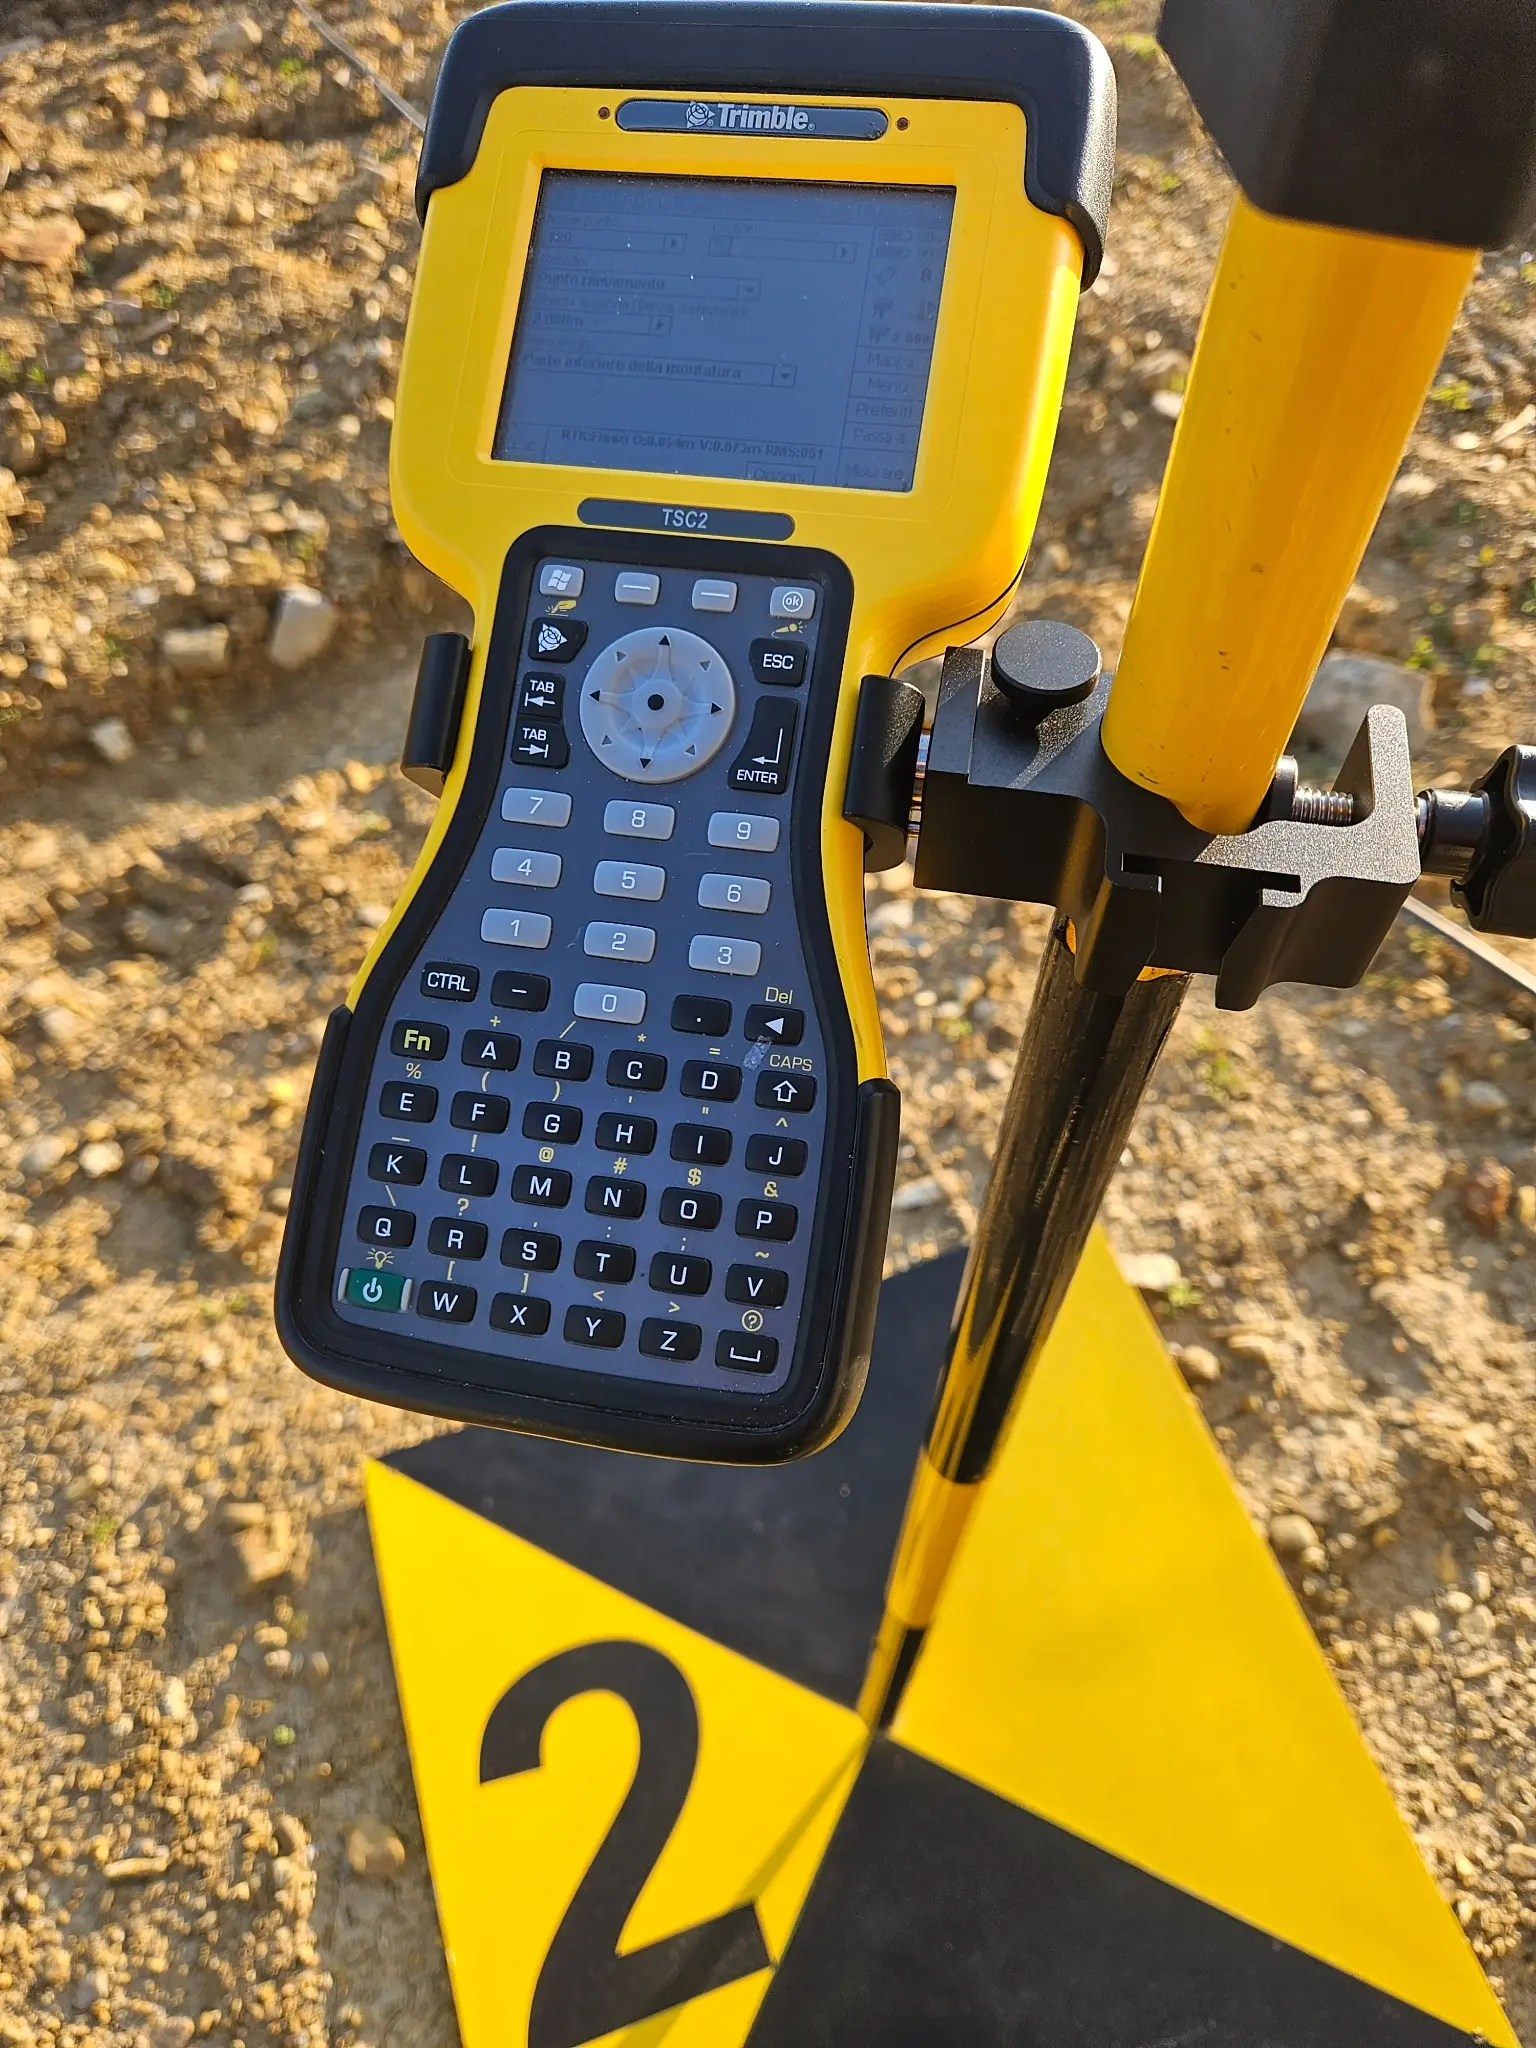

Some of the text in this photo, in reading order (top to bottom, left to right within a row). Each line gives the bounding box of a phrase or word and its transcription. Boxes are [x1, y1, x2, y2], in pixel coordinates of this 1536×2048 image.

[717, 103, 809, 131] Trimble
[662, 508, 709, 529] TSC2
[762, 652, 795, 671] ESC
[529, 679, 556, 694] TAB
[522, 727, 547, 742] TAB
[736, 769, 779, 786] ENTER
[530, 797, 544, 815] 7
[631, 810, 646, 828] 8
[737, 822, 751, 840] 9
[517, 858, 532, 877] 4
[622, 871, 636, 889] 5
[727, 884, 742, 903] 6
[510, 919, 521, 937] 1
[612, 932, 627, 951] 2
[717, 946, 732, 965] 3
[427, 972, 471, 992] CTRL
[602, 994, 617, 1013] 0
[765, 987, 794, 1005] Del
[403, 1029, 431, 1052] Fn
[481, 1041, 497, 1060] A
[555, 1051, 571, 1070] B
[769, 1053, 813, 1072] CAPS
[627, 1061, 643, 1080] C
[702, 1071, 718, 1090] D
[399, 1093, 414, 1112] E
[471, 1103, 485, 1121] F
[544, 1115, 560, 1134] G
[616, 1125, 634, 1144] H
[386, 1155, 403, 1174] K
[768, 1146, 783, 1165] J
[459, 1166, 472, 1185] L
[529, 1176, 552, 1196] M
[604, 1188, 623, 1208] N
[375, 1217, 392, 1237] Q
[756, 1210, 773, 1230] P
[446, 1229, 463, 1248] R
[521, 1242, 537, 1261] S
[596, 1253, 611, 1272] T
[670, 1265, 688, 1286] U
[747, 1277, 765, 1297] V
[432, 1291, 458, 1313] W
[510, 1305, 527, 1326] X
[586, 1317, 602, 1337] Y
[659, 1331, 678, 1351] Z
[479, 1637, 778, 2048] 2
